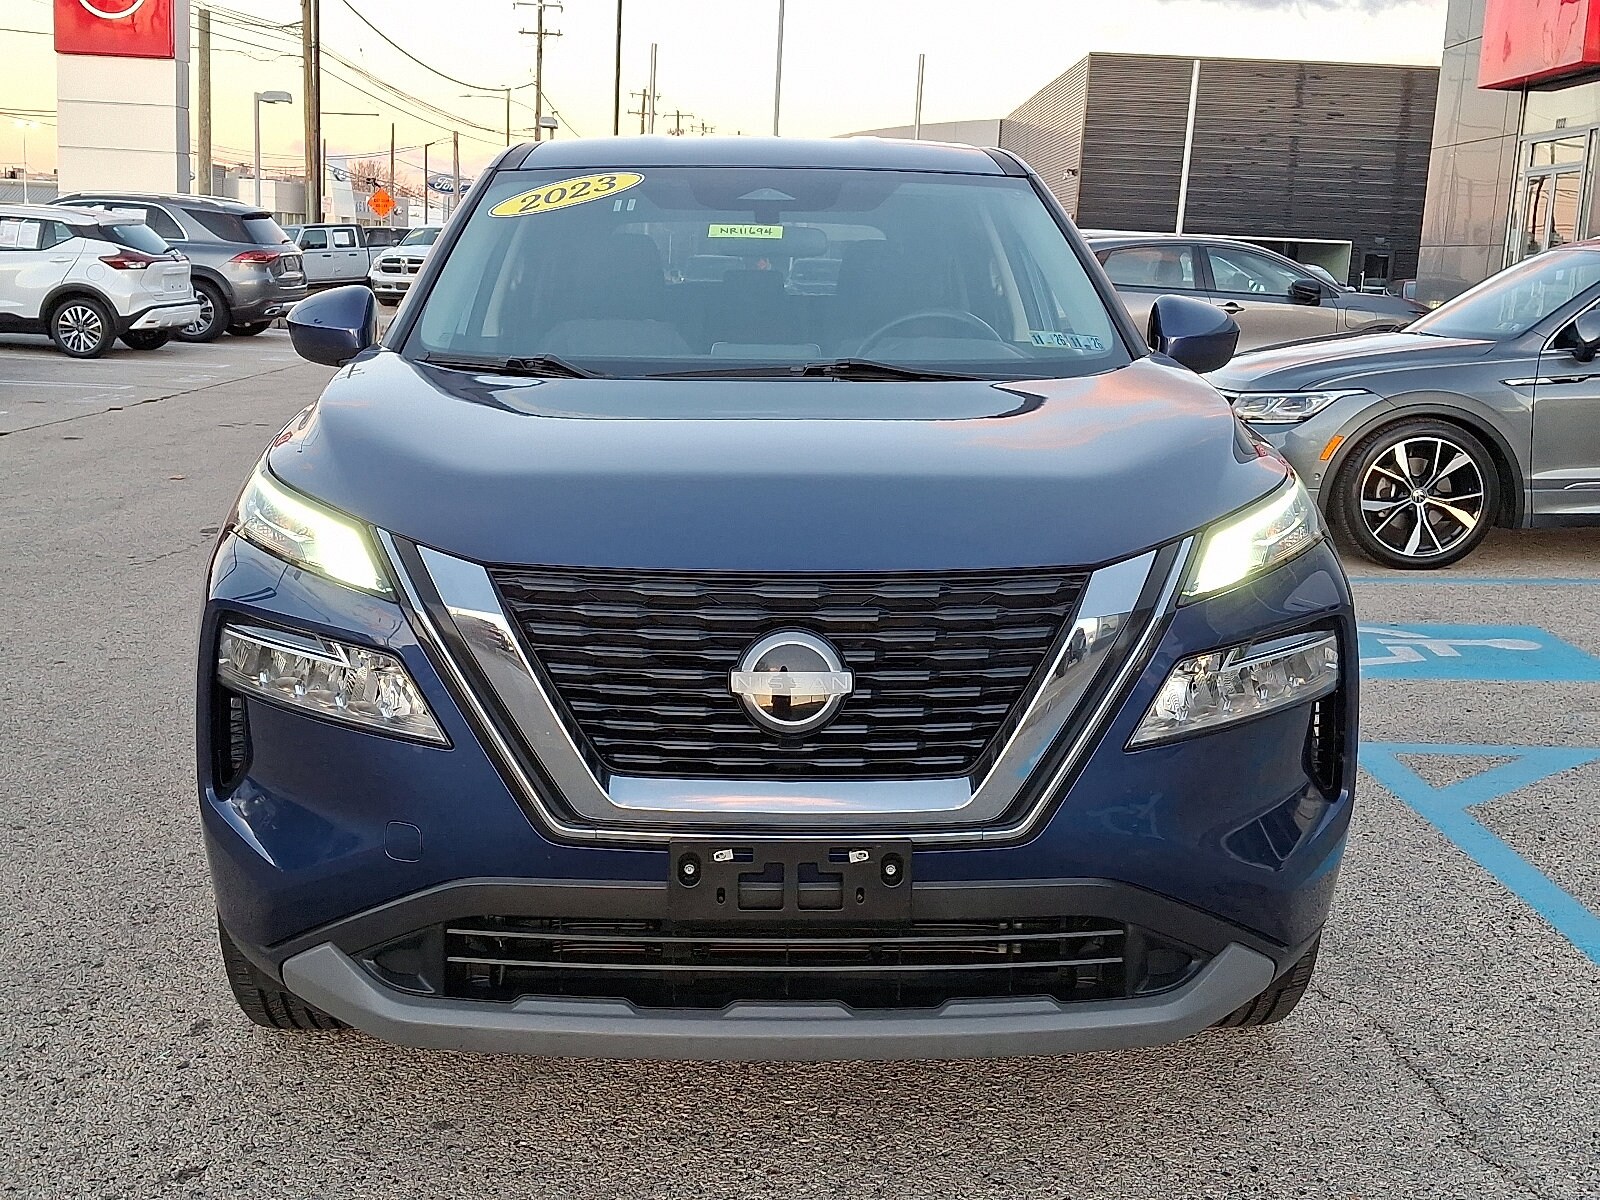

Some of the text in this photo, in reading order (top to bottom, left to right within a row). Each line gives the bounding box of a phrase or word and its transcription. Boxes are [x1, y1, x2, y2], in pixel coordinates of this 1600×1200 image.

[518, 176, 617, 213] 2023
[720, 226, 773, 236] NR11694
[735, 674, 849, 690] NISSAN
